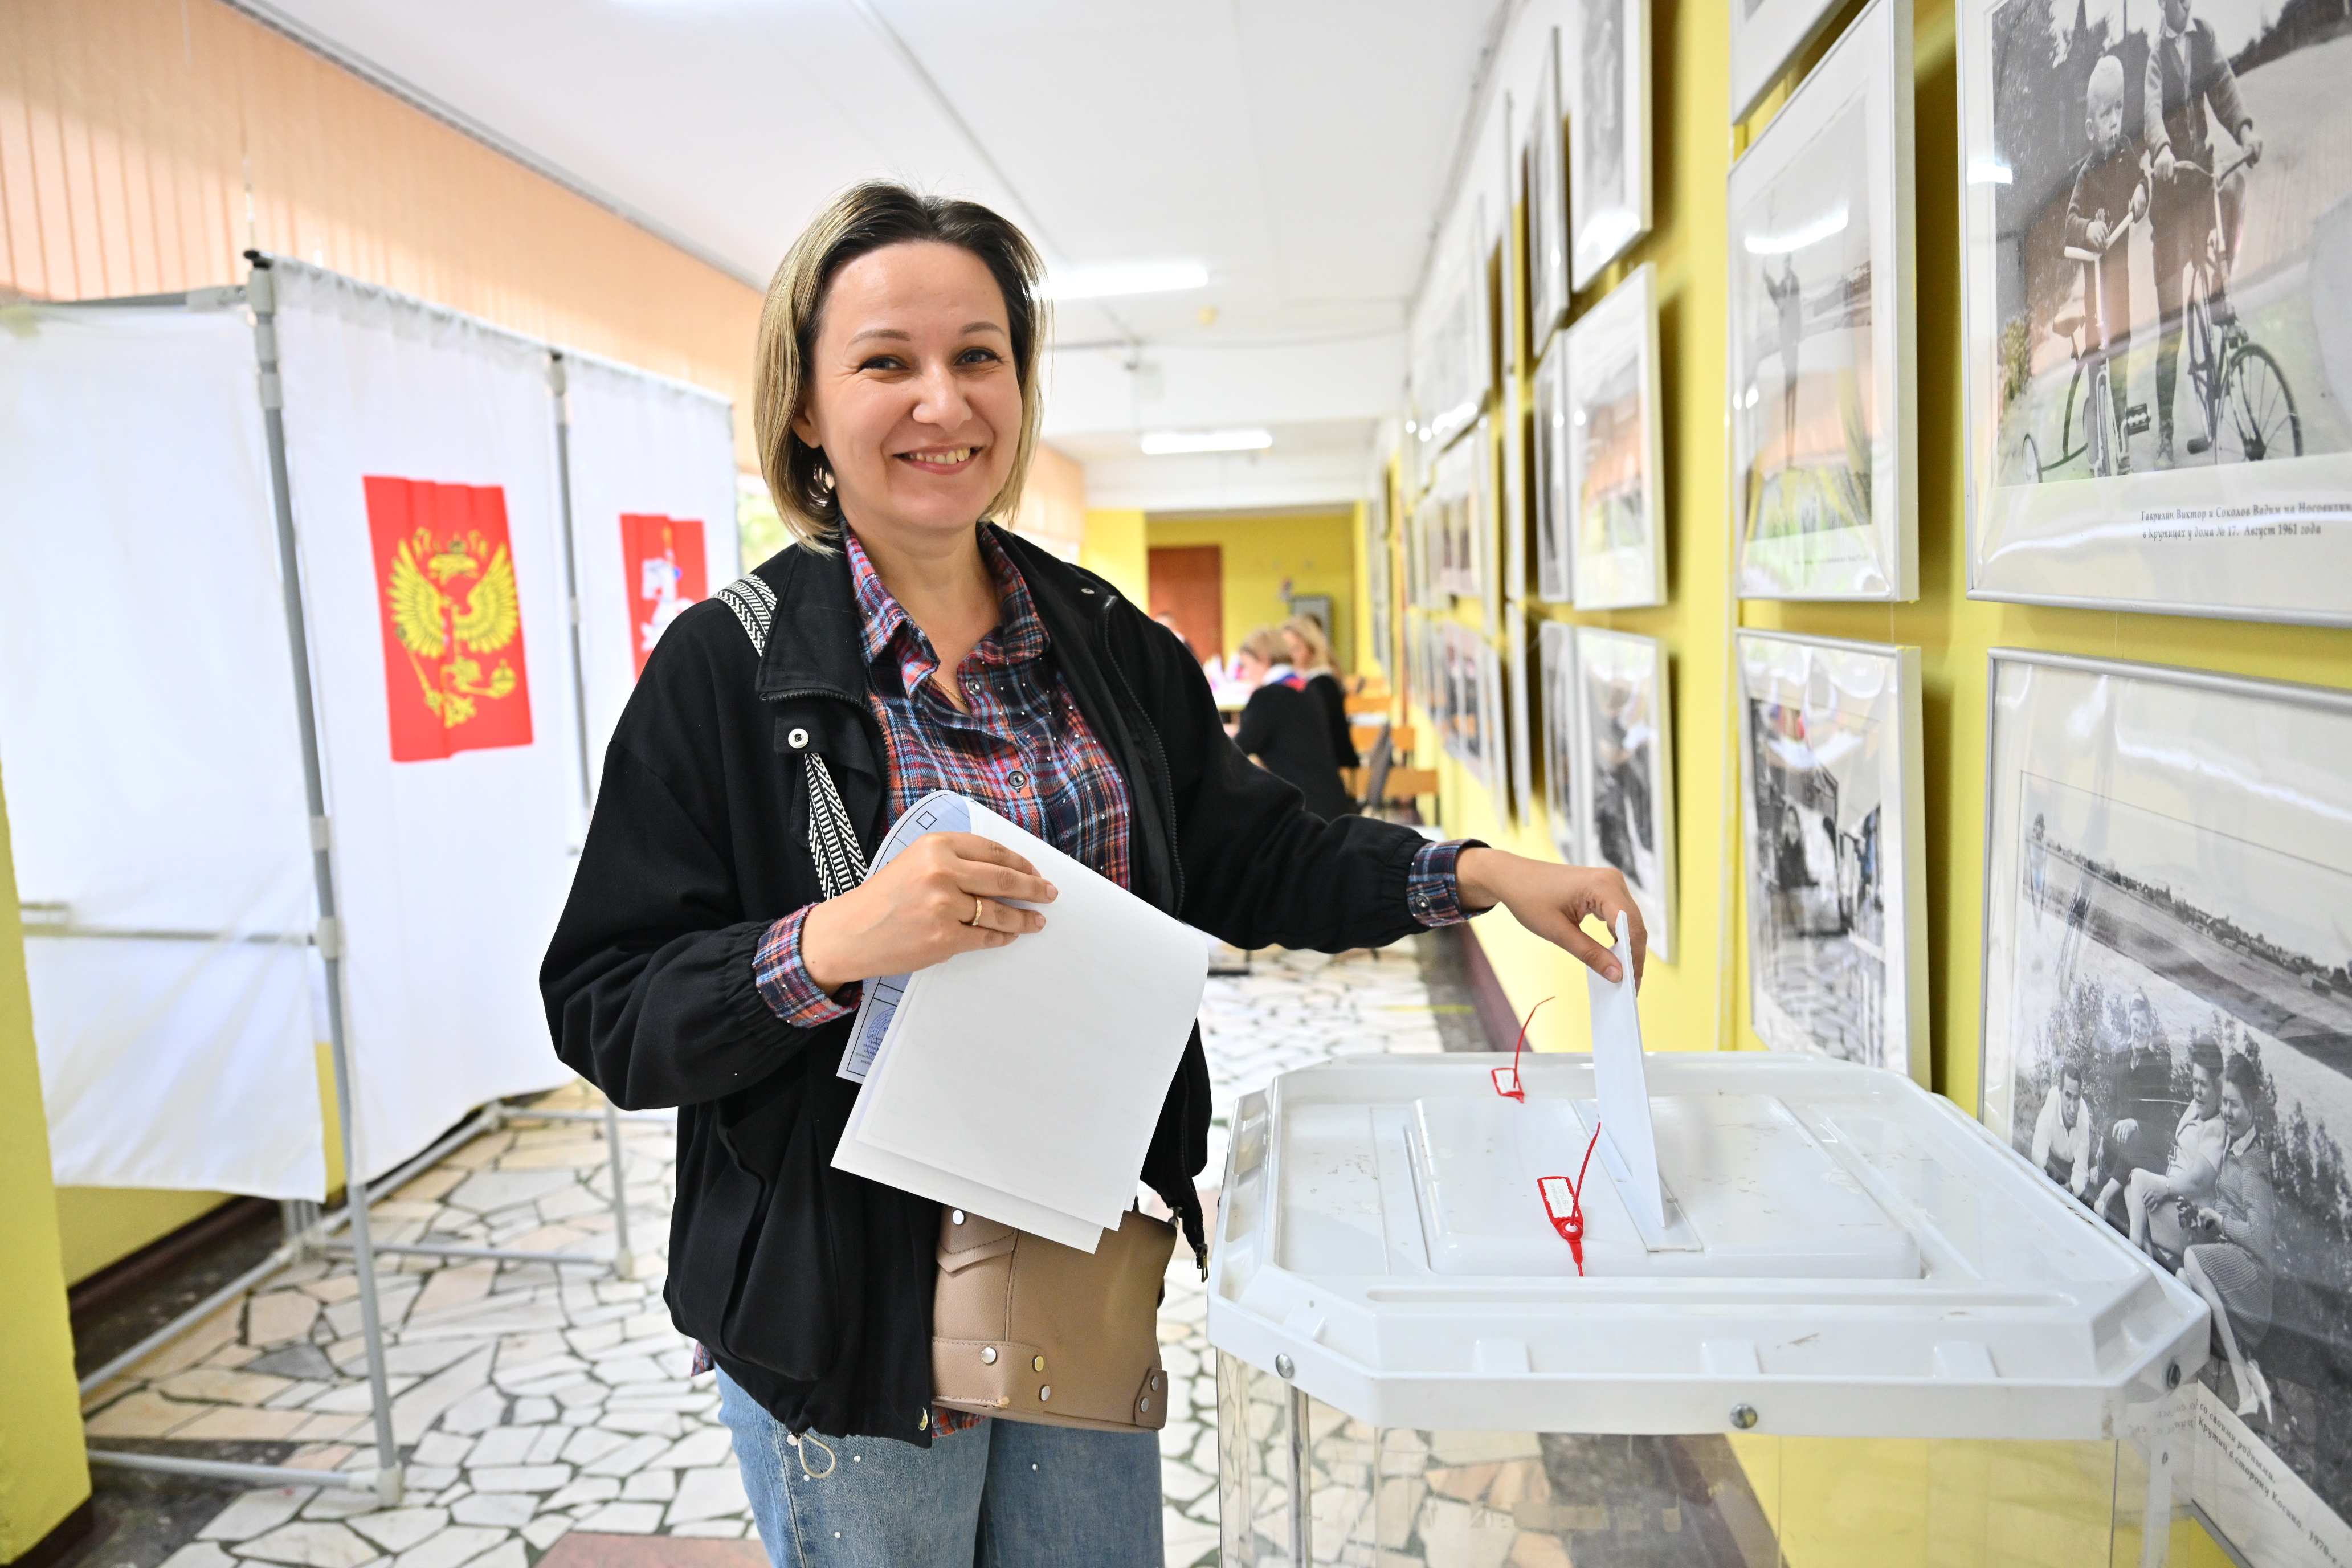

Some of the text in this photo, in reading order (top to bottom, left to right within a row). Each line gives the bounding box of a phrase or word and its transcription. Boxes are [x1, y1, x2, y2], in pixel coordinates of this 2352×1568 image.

[2141, 511, 2174, 524] Гаврилин
[2177, 509, 2206, 521] Виктор
[2216, 507, 2250, 517] Соколов
[2253, 504, 2280, 515] Вадим
[2149, 528, 2186, 541] Крутицах
[2188, 529, 2192, 541] у
[2195, 526, 2214, 537] дома
[2244, 525, 2275, 540] Август
[2278, 523, 2297, 535] 1961
[2301, 522, 2321, 534] года
[2200, 1403, 2208, 1414] со
[2210, 1413, 2236, 1442] своими
[2199, 1416, 2227, 1454] Крутиц
[2235, 1457, 2269, 1497] сторону
